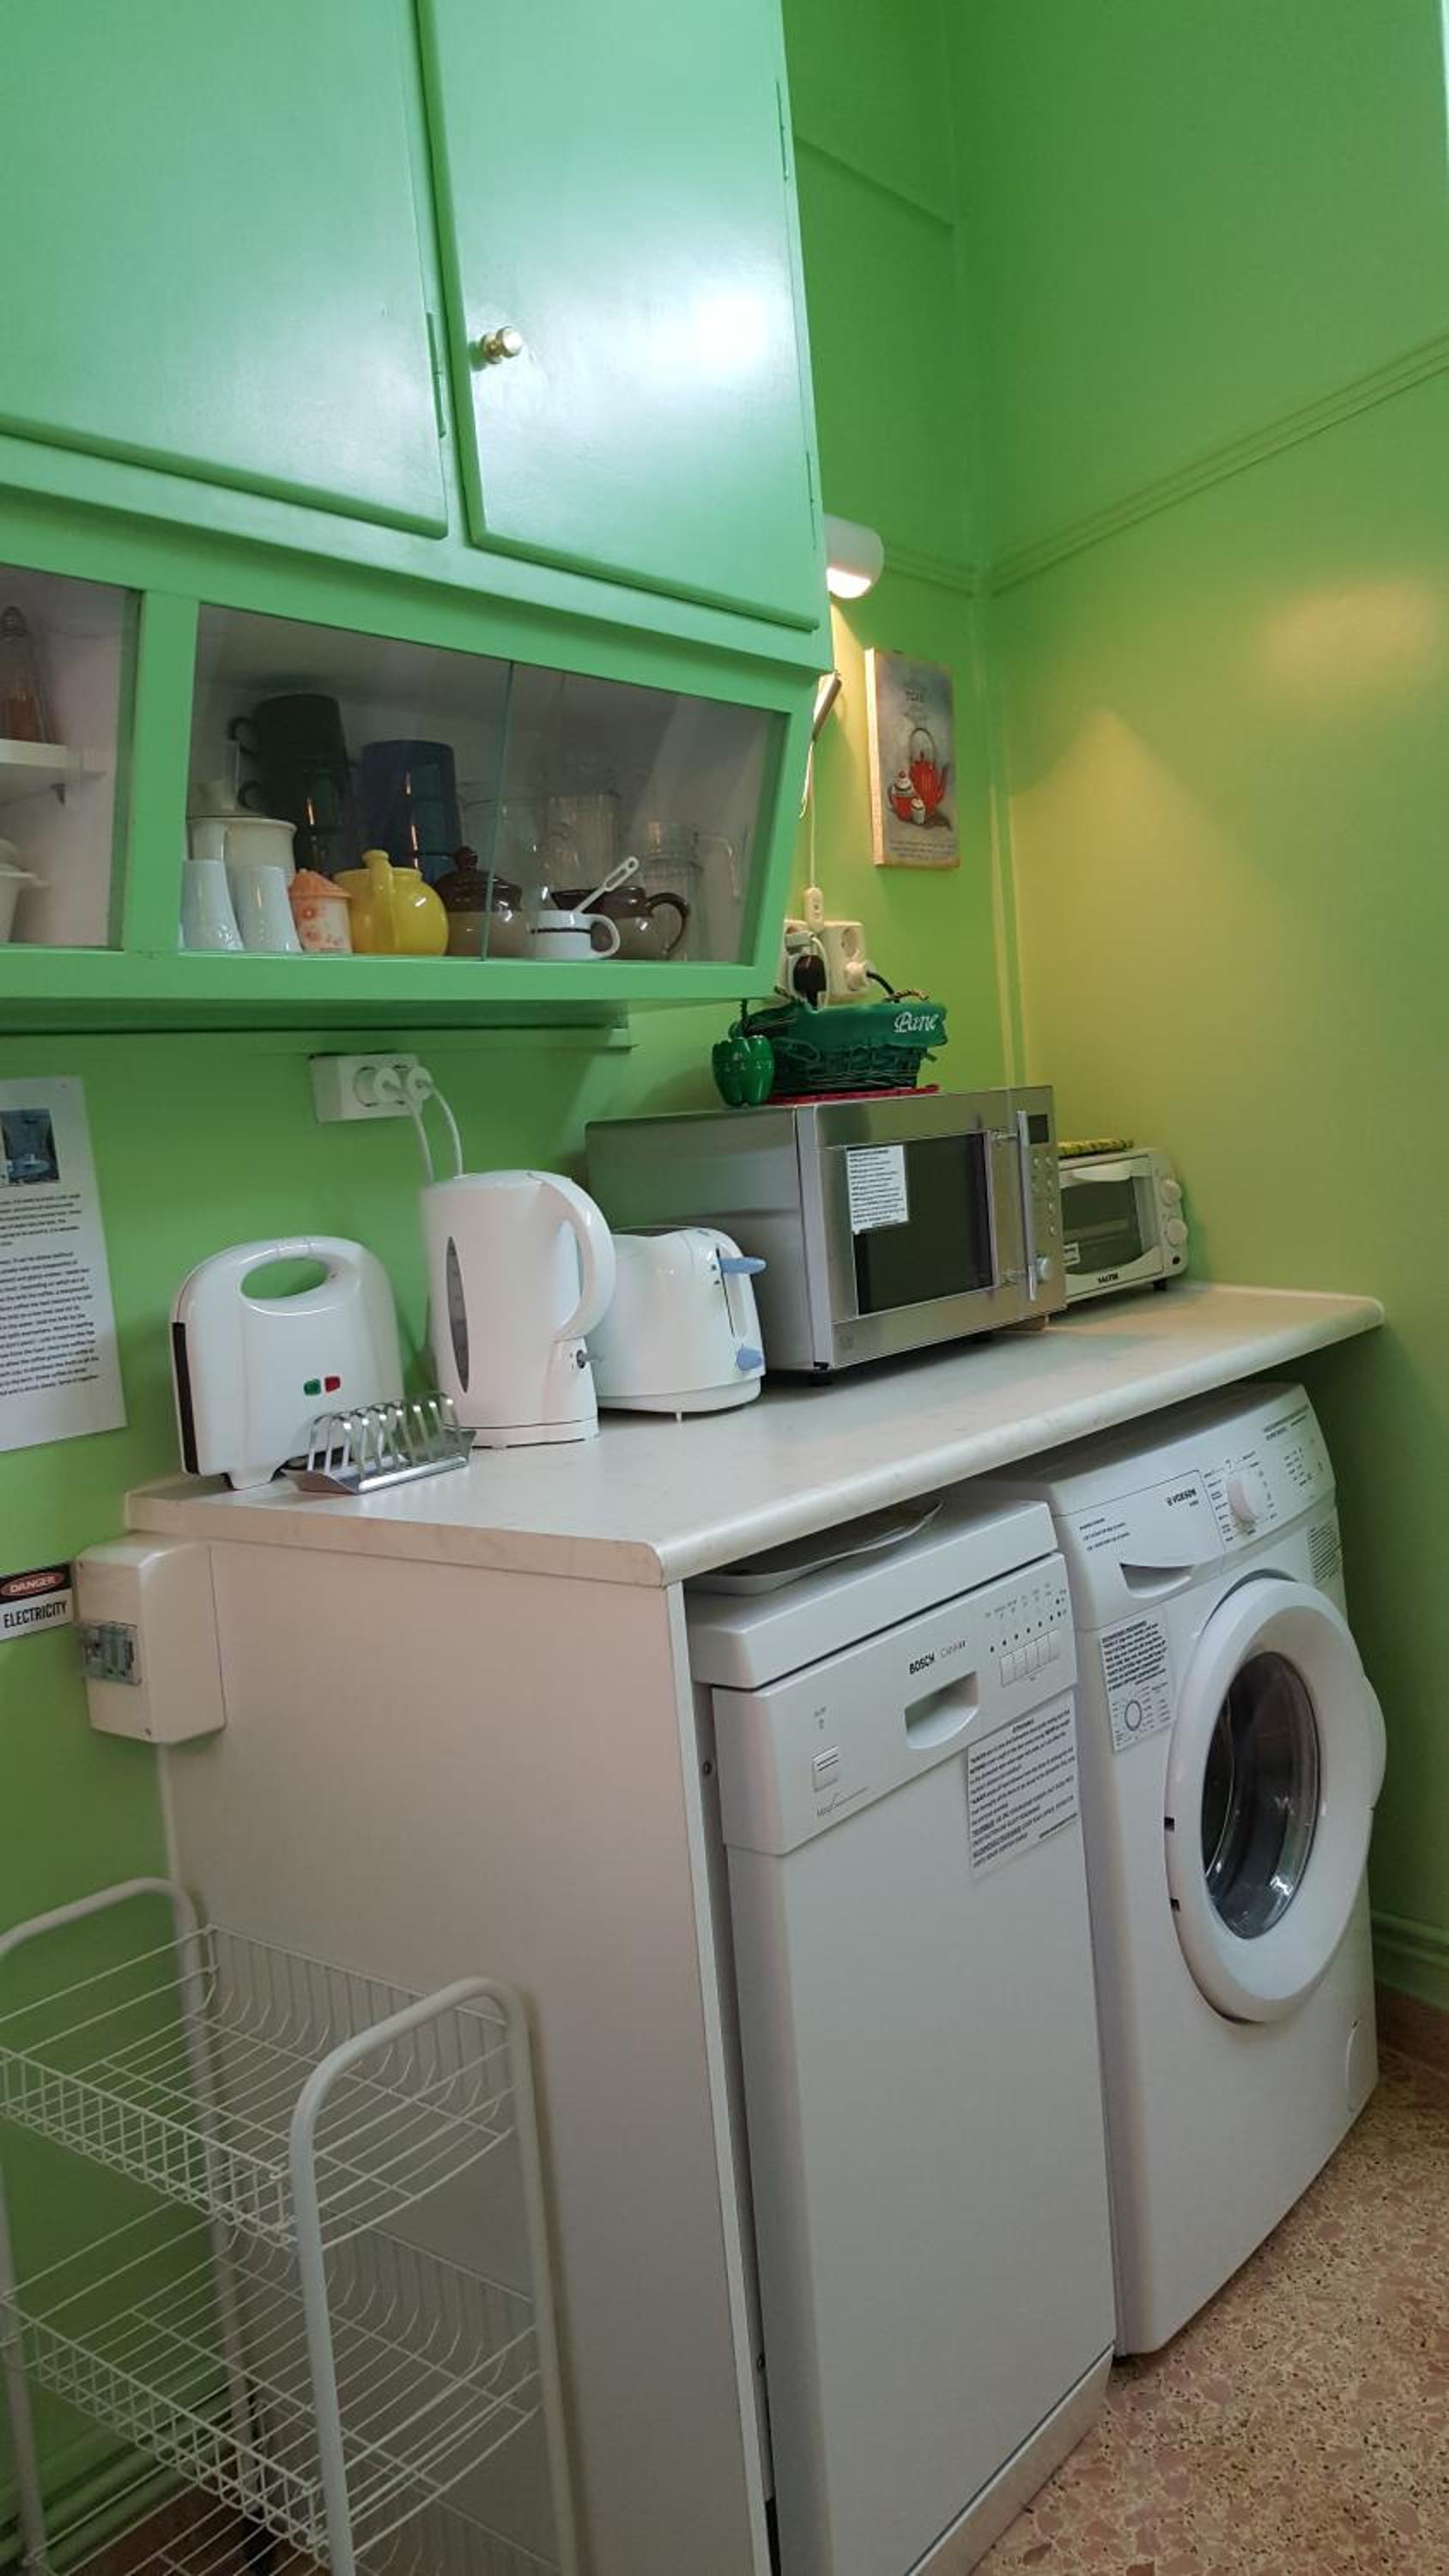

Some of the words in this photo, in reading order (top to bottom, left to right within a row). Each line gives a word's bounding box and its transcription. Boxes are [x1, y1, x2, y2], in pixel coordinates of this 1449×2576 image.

[894, 1011, 939, 1033] Pane
[9, 1576, 56, 1594] DANGER
[3, 1600, 67, 1629] ELECTRICITY
[909, 1652, 935, 1675] BOSCH
